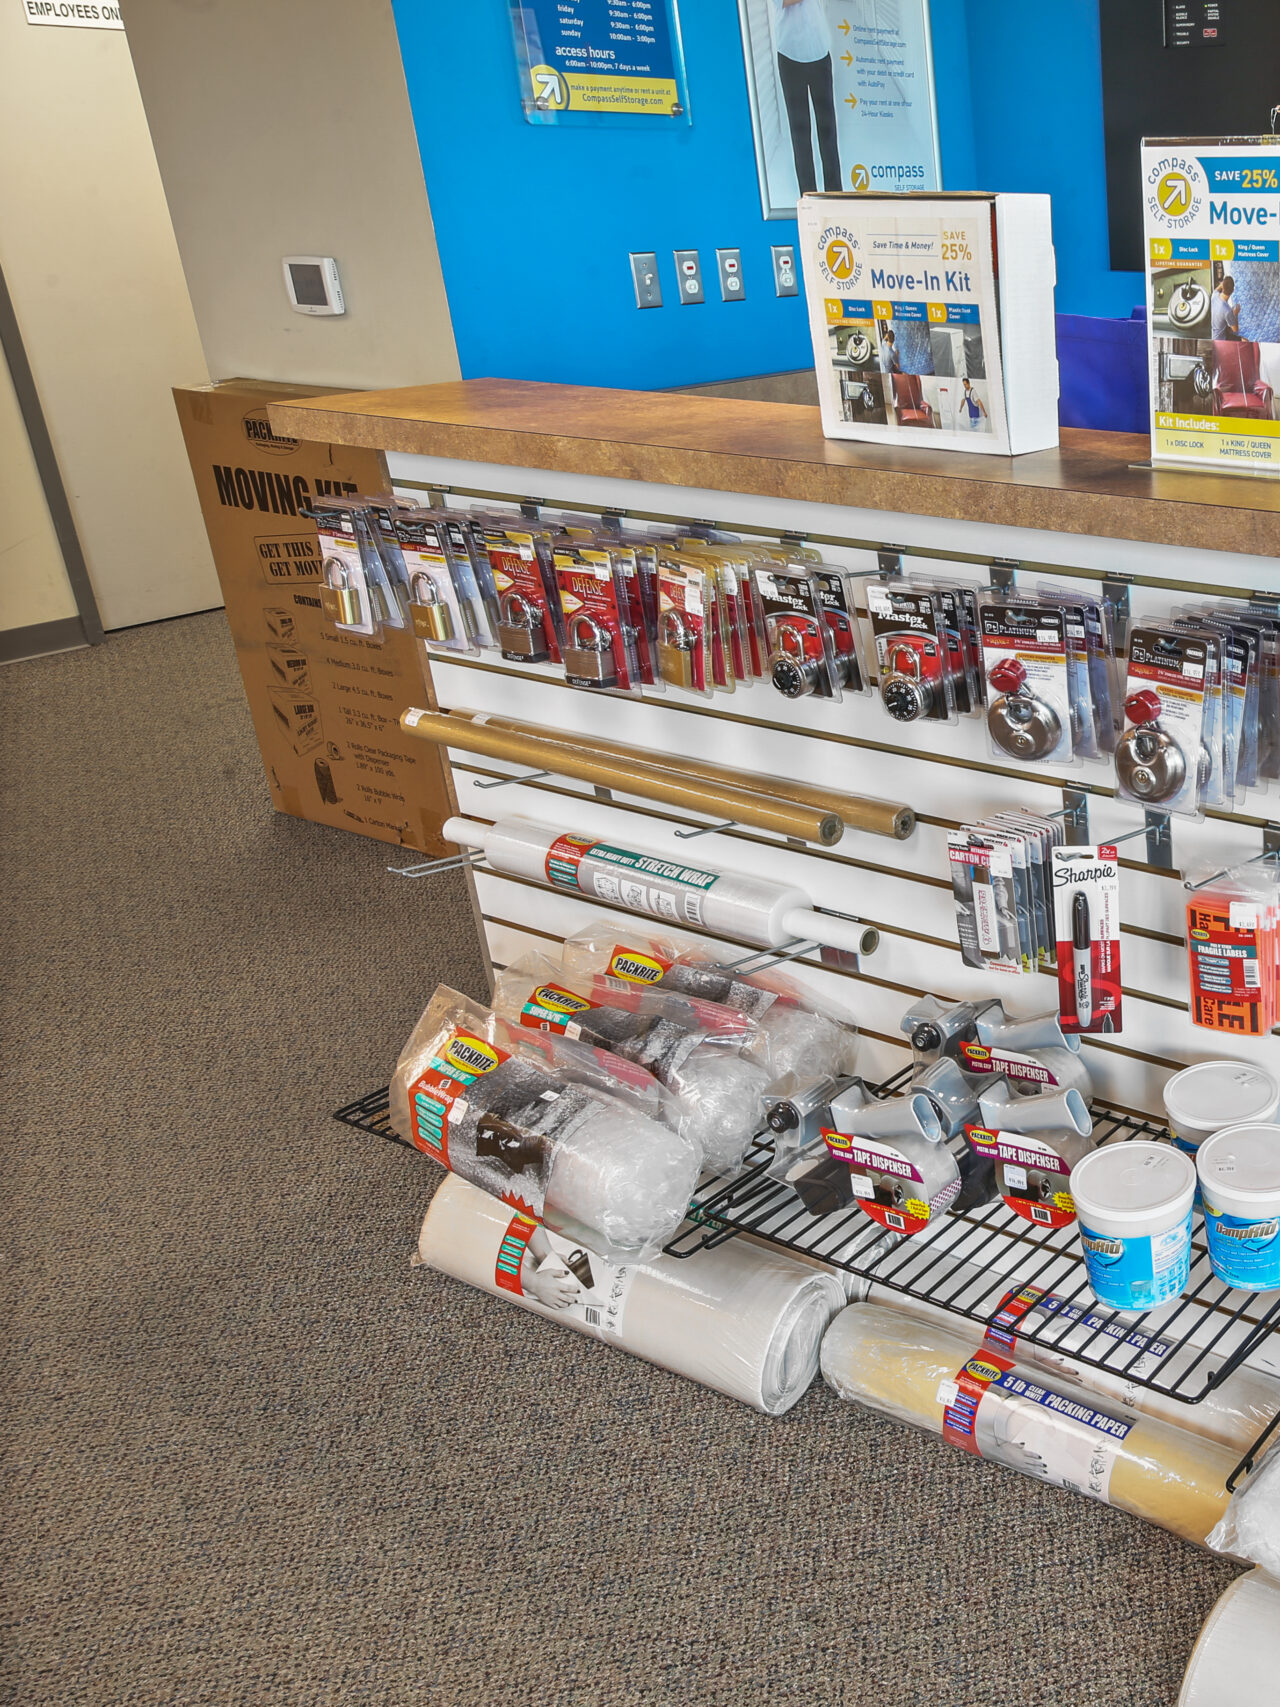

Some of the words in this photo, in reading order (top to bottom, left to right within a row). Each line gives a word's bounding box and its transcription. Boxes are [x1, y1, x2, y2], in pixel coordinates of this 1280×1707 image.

[26, 1, 100, 20] EMPLOYEES
[557, 4, 575, 15] friday
[608, 9, 629, 18] 9:30am
[559, 18, 584, 27] saturday
[561, 29, 581, 39] sunday
[609, 33, 632, 41] 10:00am
[555, 46, 588, 57] access
[589, 46, 616, 59] hours
[582, 93, 664, 106] CompassSelfStorage.com
[871, 163, 925, 182] compass
[1147, 156, 1201, 185] compass
[1214, 170, 1241, 181] SAVE
[1241, 169, 1278, 189] 25%
[1166, 195, 1202, 230] STORAGE
[942, 230, 967, 242] SAVE
[872, 240, 888, 250] Save
[888, 240, 904, 250] Time
[911, 240, 934, 251] Money!
[941, 242, 973, 262] 25%
[1153, 243, 1166, 255] 1x
[1214, 244, 1228, 256] 1x
[870, 267, 941, 292] Move-In
[944, 270, 972, 292] Kit
[827, 302, 839, 314] 1x
[876, 303, 888, 317] 1x
[1158, 415, 1174, 428] Kit
[1175, 416, 1220, 431] Includes:
[1174, 439, 1188, 448] DISC
[1188, 440, 1204, 449] LOCK
[1230, 439, 1245, 448] KING
[1250, 441, 1272, 450] QUEEN
[1219, 448, 1251, 458] MATTRESS
[1251, 450, 1272, 459] COVER
[212, 463, 315, 520] MOVING
[258, 542, 282, 559] GET
[282, 541, 313, 557] THIS
[269, 561, 292, 577] GET
[502, 554, 532, 576] DEFENSE
[571, 575, 604, 598] DEFENSE
[766, 592, 804, 606] Master
[792, 600, 809, 612] Lock
[877, 611, 924, 624] Master
[909, 620, 929, 630] Lock
[998, 625, 1037, 636] PLATINUM
[365, 641, 383, 651] Boxes
[1145, 652, 1180, 668] PLATINUM
[949, 850, 981, 863] CARTON
[589, 847, 606, 858] EXTRA
[605, 851, 622, 863] HEAVY
[620, 856, 636, 866] DUTY
[634, 856, 680, 880] STRETCH
[680, 870, 715, 888] WRAP
[1052, 864, 1116, 888] Sharpie
[1197, 945, 1223, 956] FRAGILE
[1223, 949, 1248, 958] LABELS
[614, 957, 664, 984] PACKRITE
[537, 986, 589, 1012] PACKRITE
[1203, 996, 1216, 1026] Care
[447, 1039, 499, 1073] PACKRITE
[436, 1060, 457, 1077] SUPER
[992, 1059, 1010, 1076] TAPE
[1009, 1063, 1050, 1084] DISPENSER
[417, 1079, 454, 1105] BubbleWrap
[826, 1134, 850, 1148] PACKRITE
[971, 1130, 995, 1145] PACKRITE
[852, 1148, 872, 1166] TAPE
[871, 1154, 913, 1179] DISPENSER
[997, 1144, 1018, 1161] TAPE
[1017, 1148, 1061, 1173] DISPENSER
[1215, 1219, 1279, 1241] DampRid
[966, 1360, 1002, 1381] PACKRITE
[1024, 1389, 1043, 1403] WHITE
[1028, 1385, 1046, 1396] CLEAN
[1045, 1393, 1097, 1424] PACKING
[1091, 1413, 1129, 1439] PAPER
